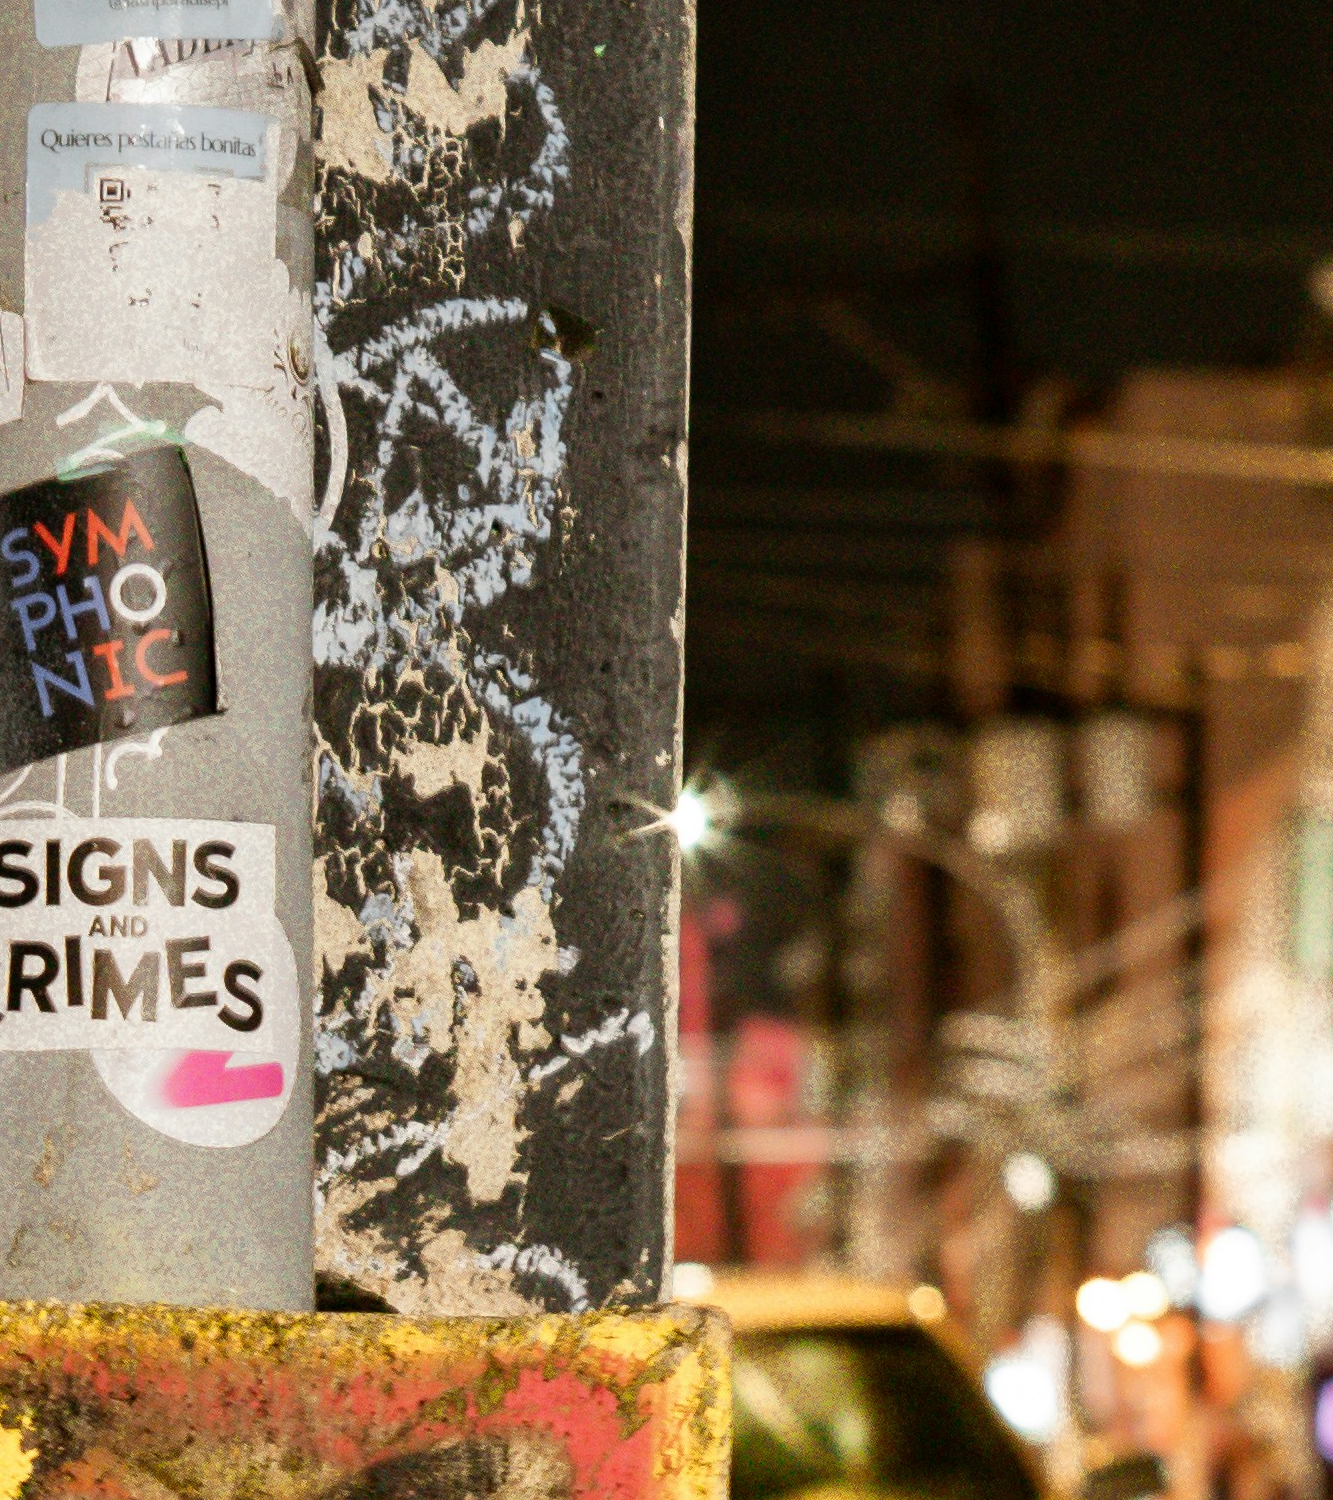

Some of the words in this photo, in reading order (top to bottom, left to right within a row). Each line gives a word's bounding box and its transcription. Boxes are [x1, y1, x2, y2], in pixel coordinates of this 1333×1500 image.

[41, 128, 113, 151] Quieres
[0, 496, 157, 589] SYM
[10, 562, 168, 652] PHO
[31, 629, 189, 719] NIC
[87, 913, 150, 939] AND
